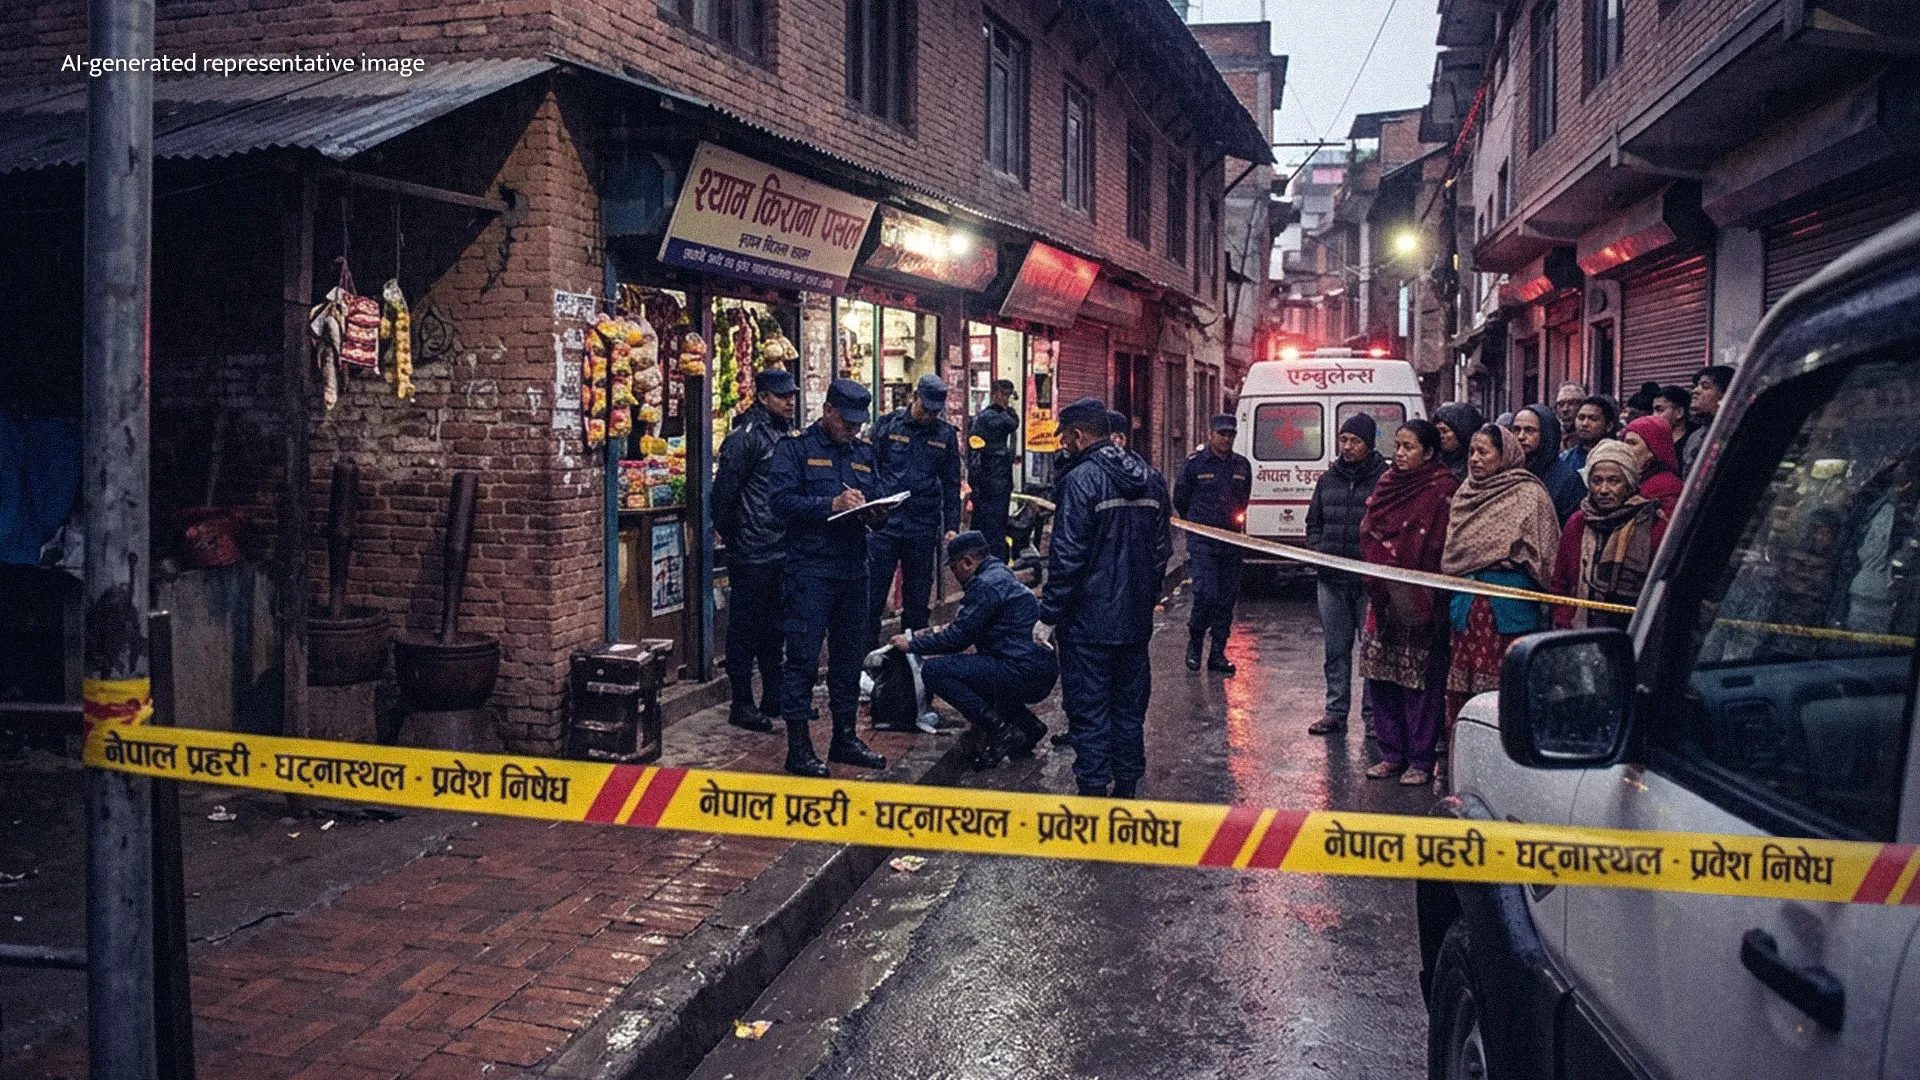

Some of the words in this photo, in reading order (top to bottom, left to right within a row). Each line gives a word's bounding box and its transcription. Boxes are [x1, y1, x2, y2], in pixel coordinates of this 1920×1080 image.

[695, 167, 756, 220] श्याम
[752, 173, 822, 238] किराना
[821, 207, 865, 250] पसल
[105, 731, 176, 769] नेपाल
[186, 742, 250, 777] प्रहरी
[433, 760, 492, 799] प्रवेश
[501, 766, 569, 804] निषेध
[700, 780, 775, 820] नेपाल
[785, 790, 850, 827] प्रहरी
[1038, 805, 1098, 843] प्रवेश
[1109, 808, 1181, 848] निषेध
[1325, 821, 1404, 862] नेपाल
[1416, 829, 1485, 867] प्रहरी
[1690, 842, 1752, 881] प्रवेश
[1762, 844, 1834, 885] निषेध
